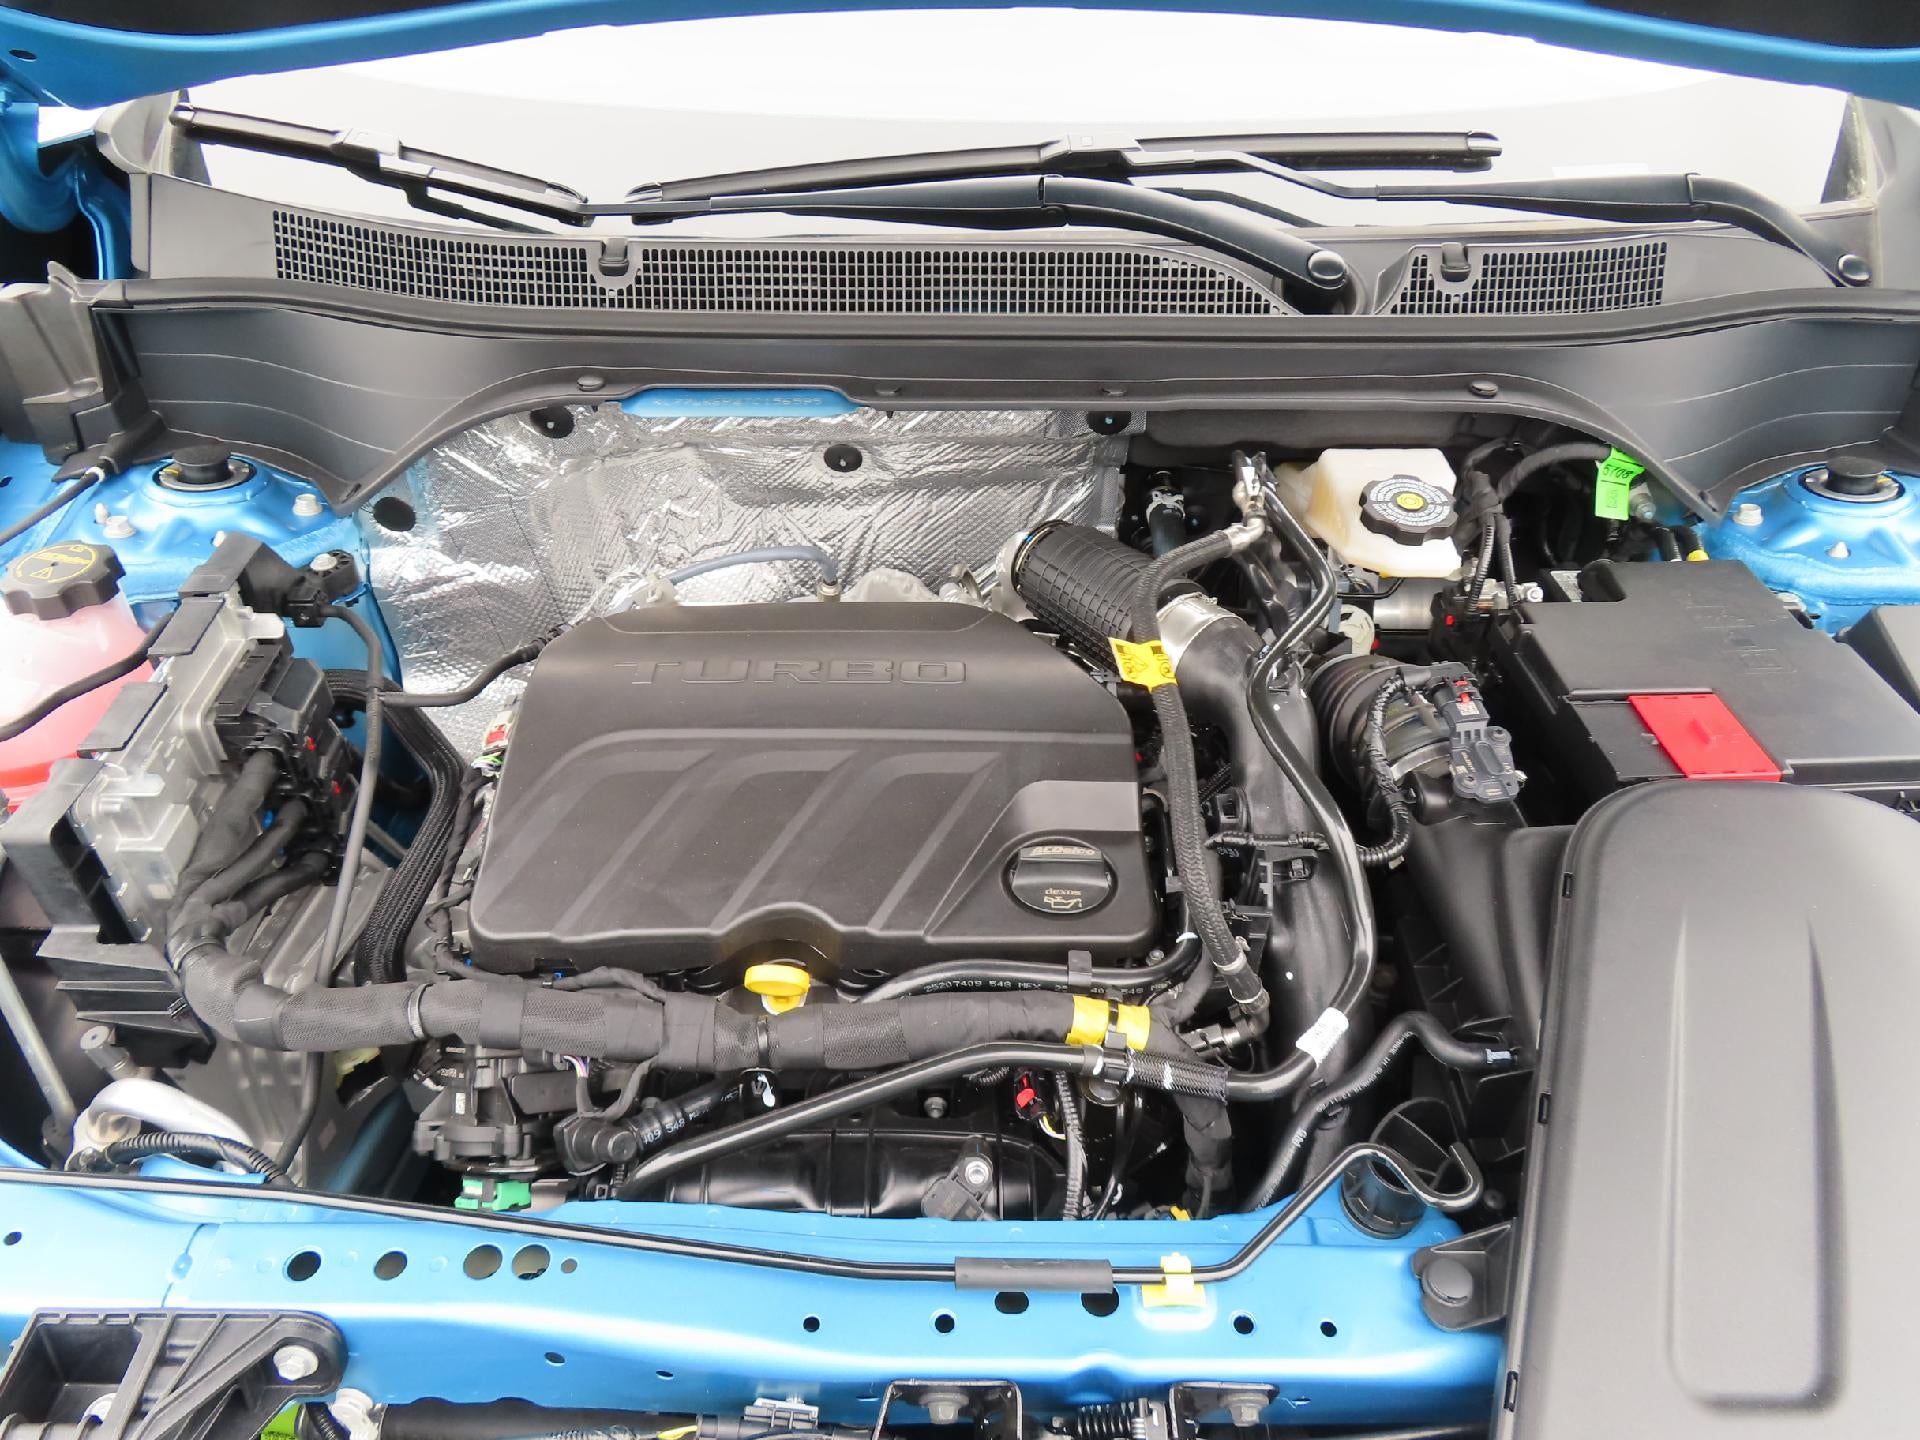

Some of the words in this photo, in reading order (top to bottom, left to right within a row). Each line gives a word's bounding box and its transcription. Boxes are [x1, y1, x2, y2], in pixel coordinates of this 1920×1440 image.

[614, 660, 966, 684] TURBO
[1030, 846, 1095, 856] ACDelco
[924, 980, 982, 992] 25207409
[989, 980, 1012, 988] 548
[665, 1119, 685, 1133] 548
